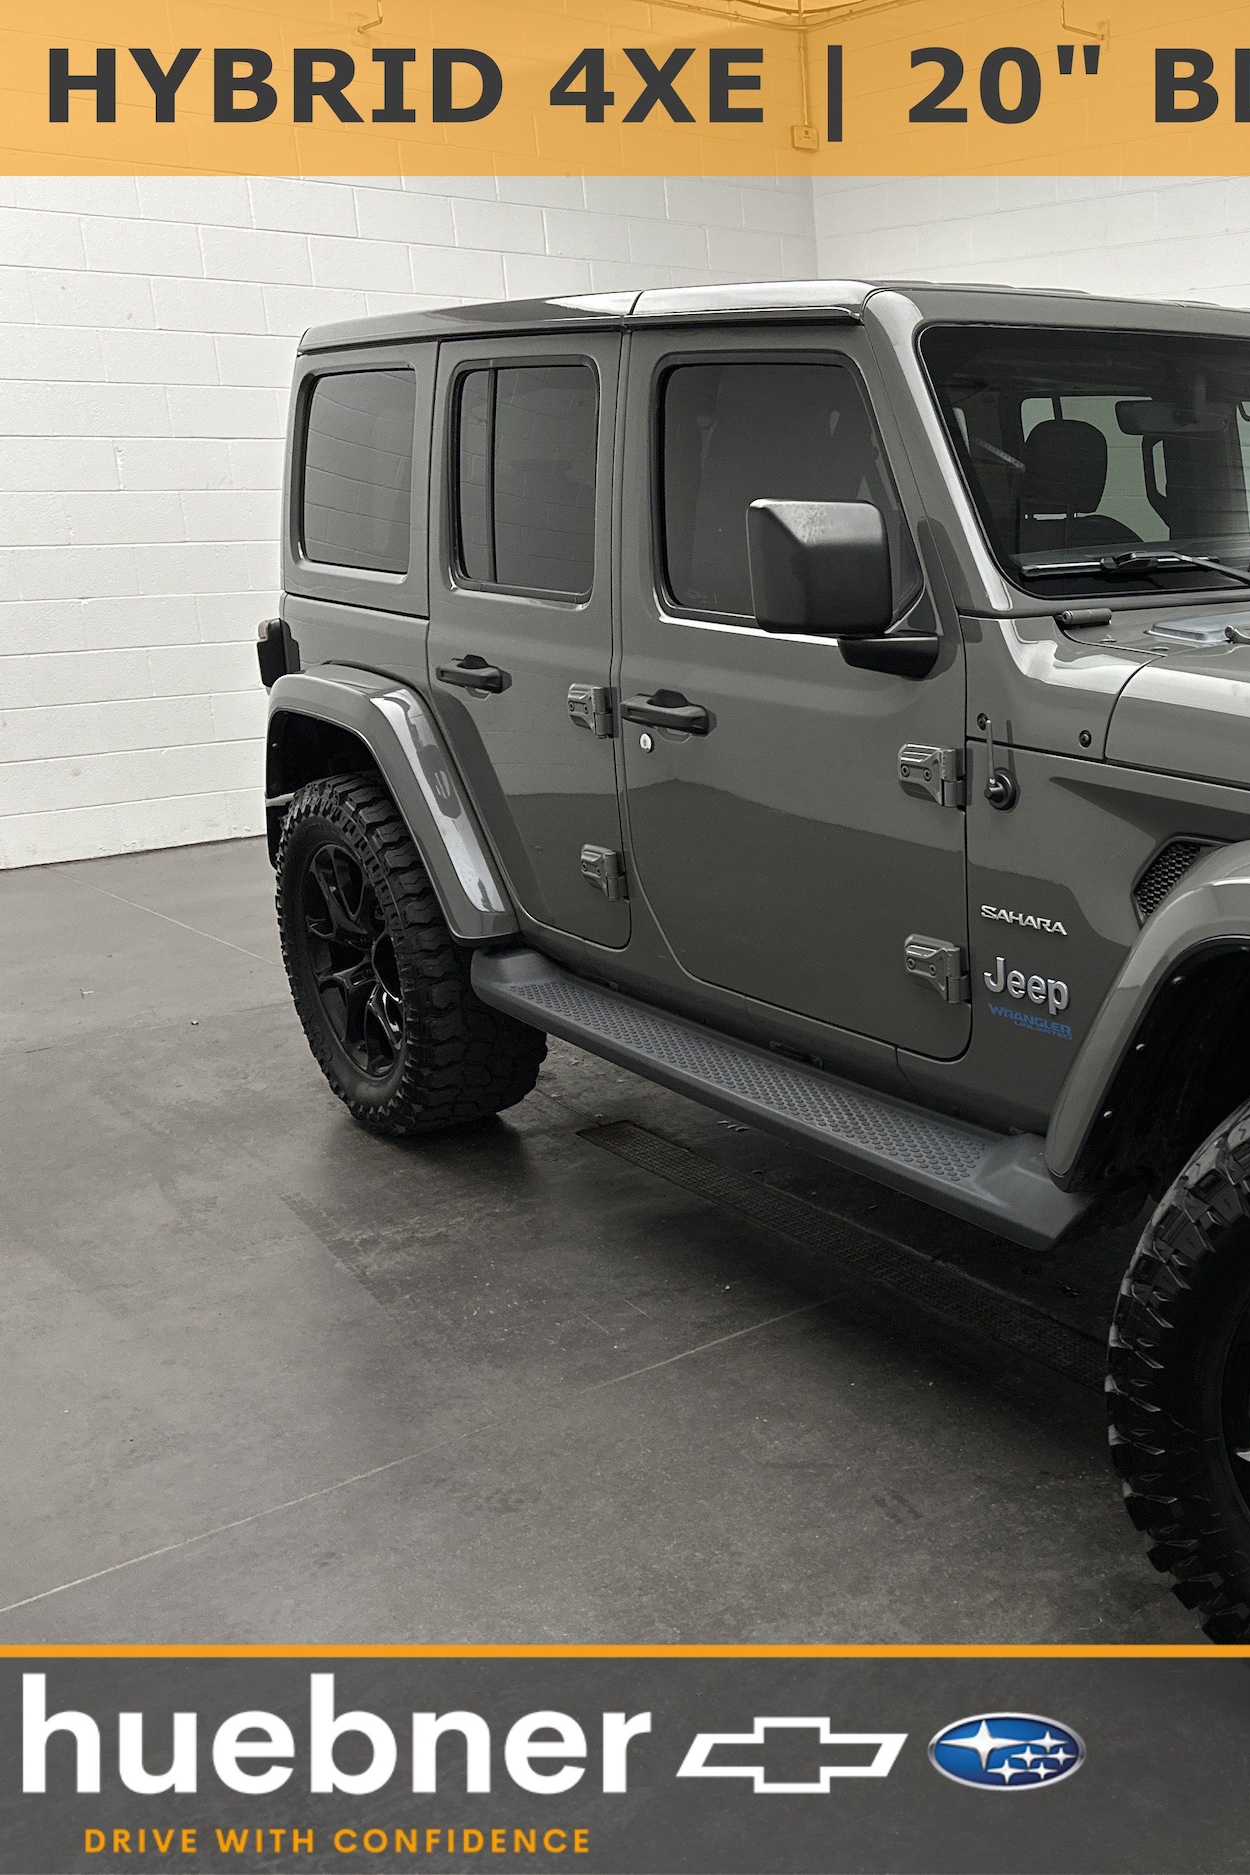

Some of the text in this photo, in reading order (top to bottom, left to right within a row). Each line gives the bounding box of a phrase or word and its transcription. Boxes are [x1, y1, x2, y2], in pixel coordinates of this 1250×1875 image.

[980, 904, 1067, 936] SAHARA
[983, 956, 1070, 1015] Jeep
[988, 1003, 1071, 1034] WRANGLER
